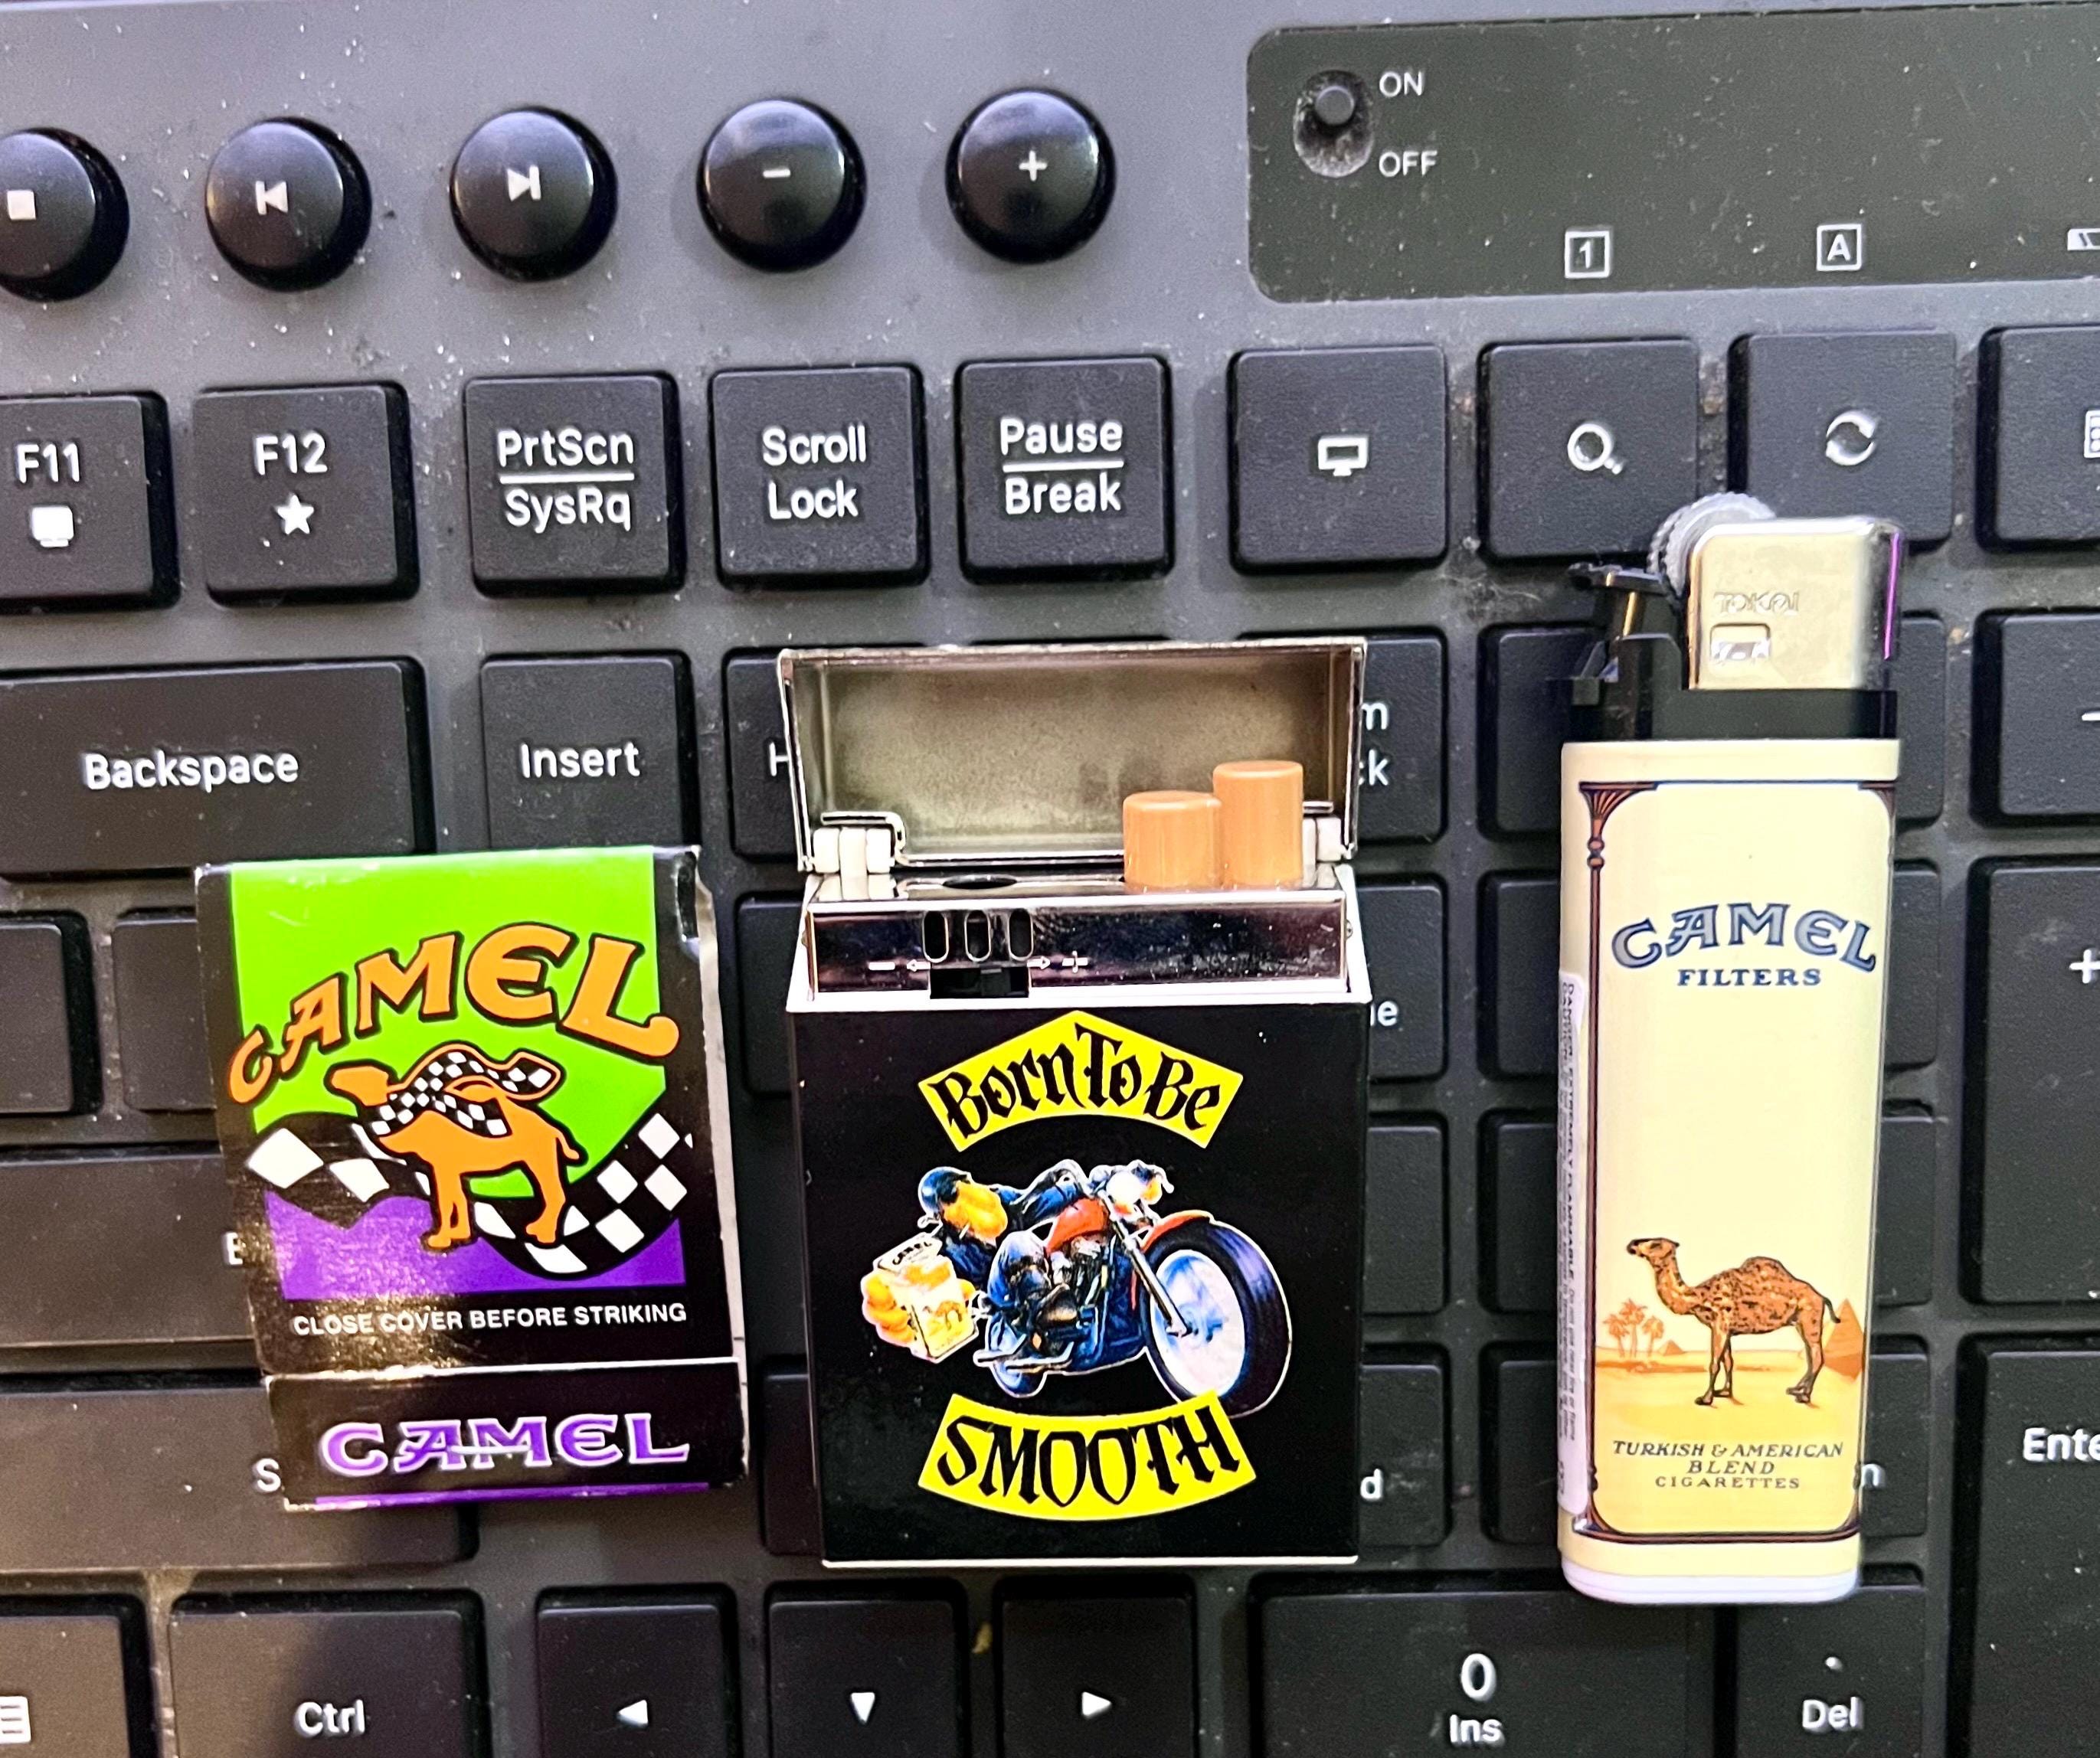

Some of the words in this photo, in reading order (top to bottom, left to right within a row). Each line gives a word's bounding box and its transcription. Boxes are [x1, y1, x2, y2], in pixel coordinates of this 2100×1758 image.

[1379, 70, 1424, 97] ON
[1379, 150, 1438, 177] OFF
[1827, 233, 1851, 261] A
[254, 430, 329, 476] F12
[497, 427, 635, 468] PrtScn
[762, 424, 867, 466] Scroll
[999, 417, 1124, 456] Pause
[15, 442, 80, 484] F11
[504, 488, 632, 532] SysRq
[767, 479, 859, 520] Lock
[1003, 472, 1122, 515] Break
[83, 749, 299, 794] Backspace
[520, 741, 641, 779] Insert
[1611, 902, 1876, 973] CAMEL
[1677, 969, 1821, 986] FILTERS
[227, 923, 681, 1104] CAMEL
[928, 1043, 1086, 1139] Born
[1074, 1022, 1142, 1108] To
[1143, 1051, 1221, 1130] Be
[293, 1315, 373, 1336] CLOSE
[382, 1312, 463, 1332] COVER
[469, 1307, 567, 1329] BEFORE
[574, 1302, 687, 1325] STRIKING
[320, 1413, 690, 1477] CAMEL
[937, 1403, 1242, 1508] SMOOTH
[1613, 1440, 1706, 1456] TURKISH
[1711, 1443, 1728, 1457] &
[1730, 1441, 1844, 1458] AMERICAN
[1655, 1475, 1800, 1489] CIGARETTES
[1686, 1460, 1775, 1475] BLEND
[1460, 1652, 1496, 1701] 0
[295, 1698, 366, 1737] Ctrl
[1448, 1714, 1504, 1745] Ins
[1802, 1695, 1863, 1731] Del
